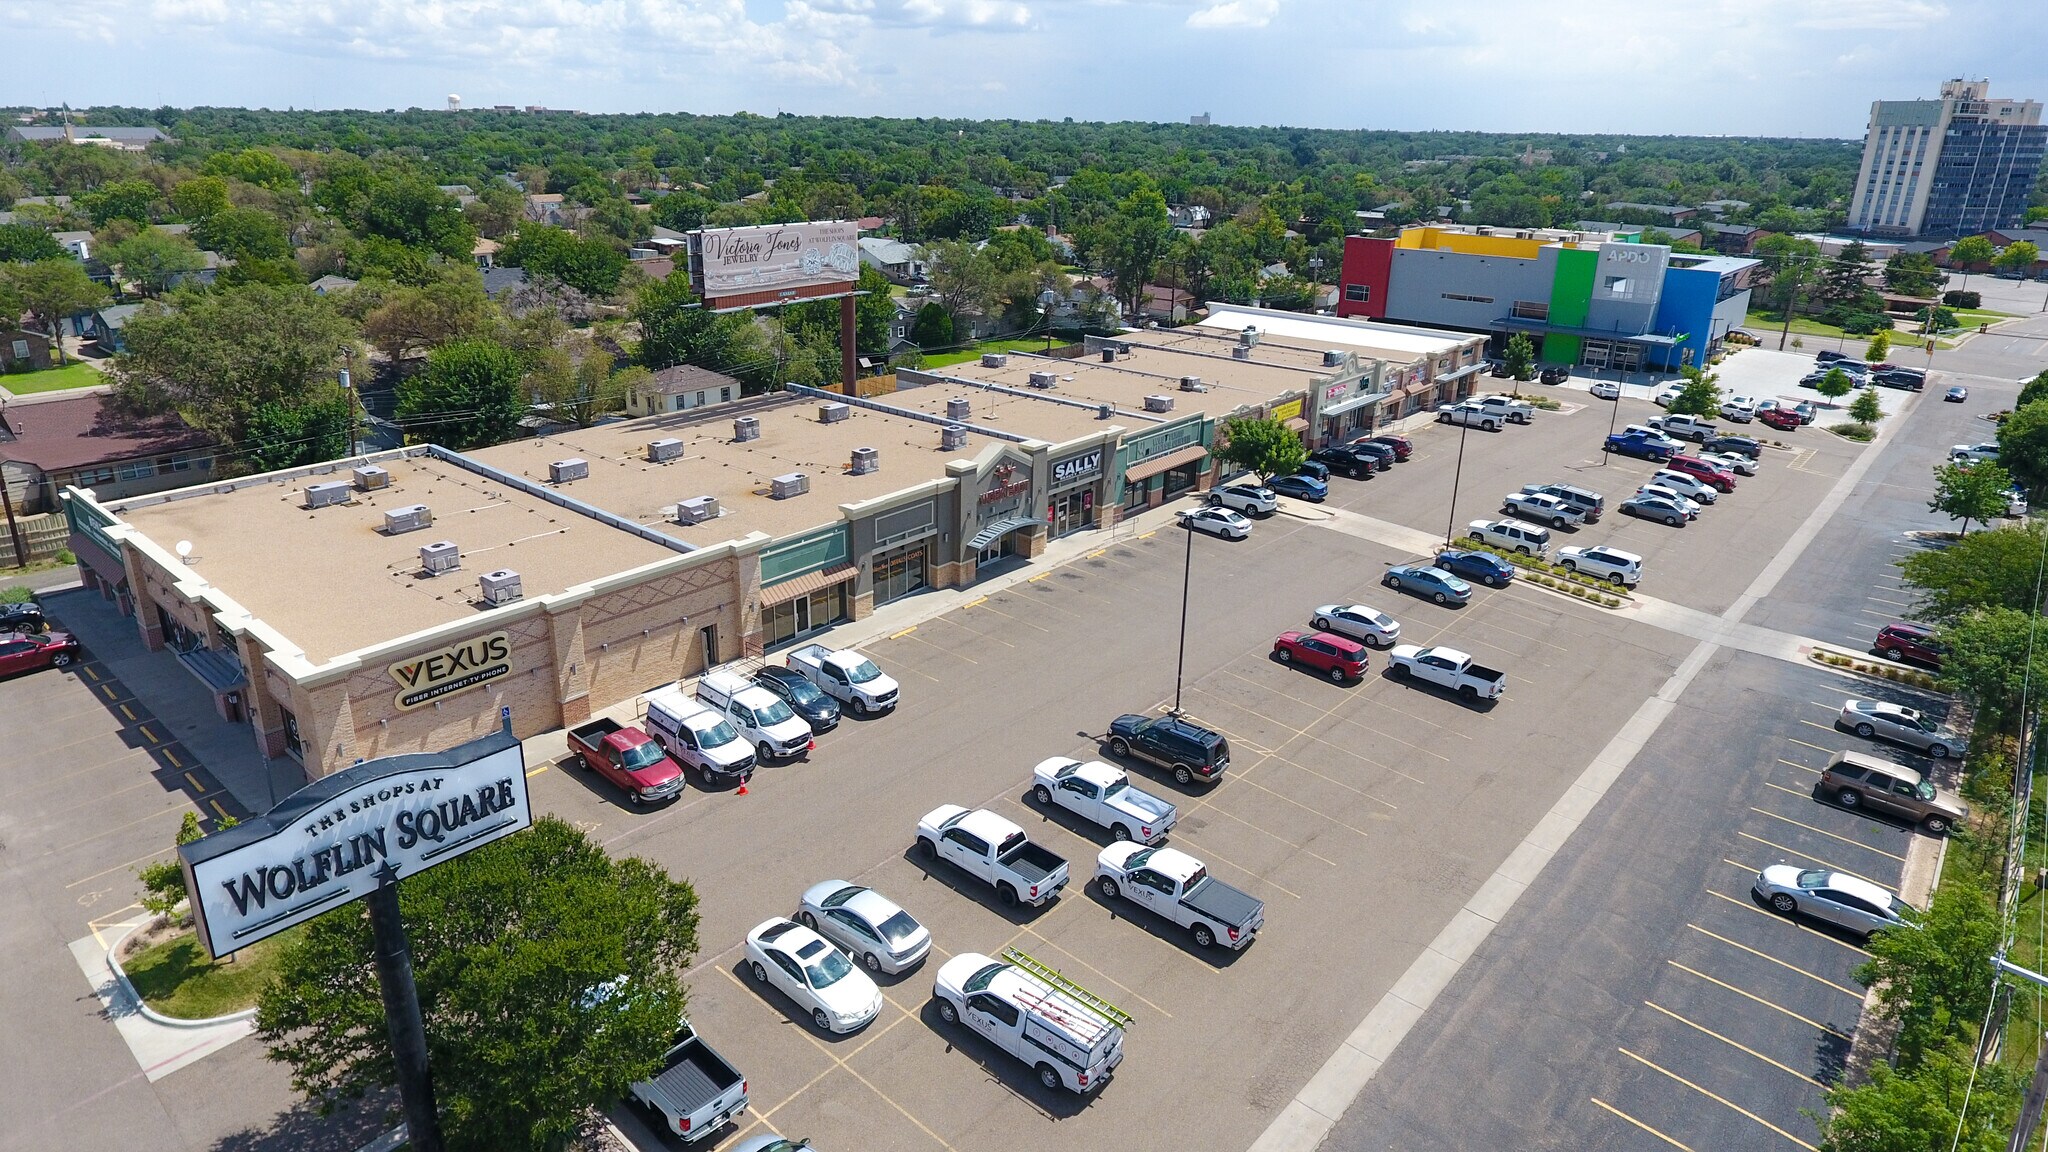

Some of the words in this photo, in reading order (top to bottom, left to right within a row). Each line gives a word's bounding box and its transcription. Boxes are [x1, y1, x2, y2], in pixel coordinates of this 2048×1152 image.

[703, 231, 762, 260] Victoria
[763, 229, 802, 262] Jones
[723, 253, 759, 266] JEWELRY
[1055, 452, 1100, 479] SALLY
[396, 636, 508, 687] VEXUS
[405, 693, 429, 705] FIBER
[430, 679, 468, 696] INTERNET
[469, 675, 480, 683] TV
[481, 666, 508, 679] PHONE
[304, 807, 347, 838] THE
[349, 780, 415, 814] SHOPS
[418, 777, 444, 793] AT
[221, 824, 389, 917] WOLFLIN
[396, 776, 516, 850] SQUARE
[1128, 884, 1153, 901] VEXUS
[966, 1009, 992, 1032] VEXUS
